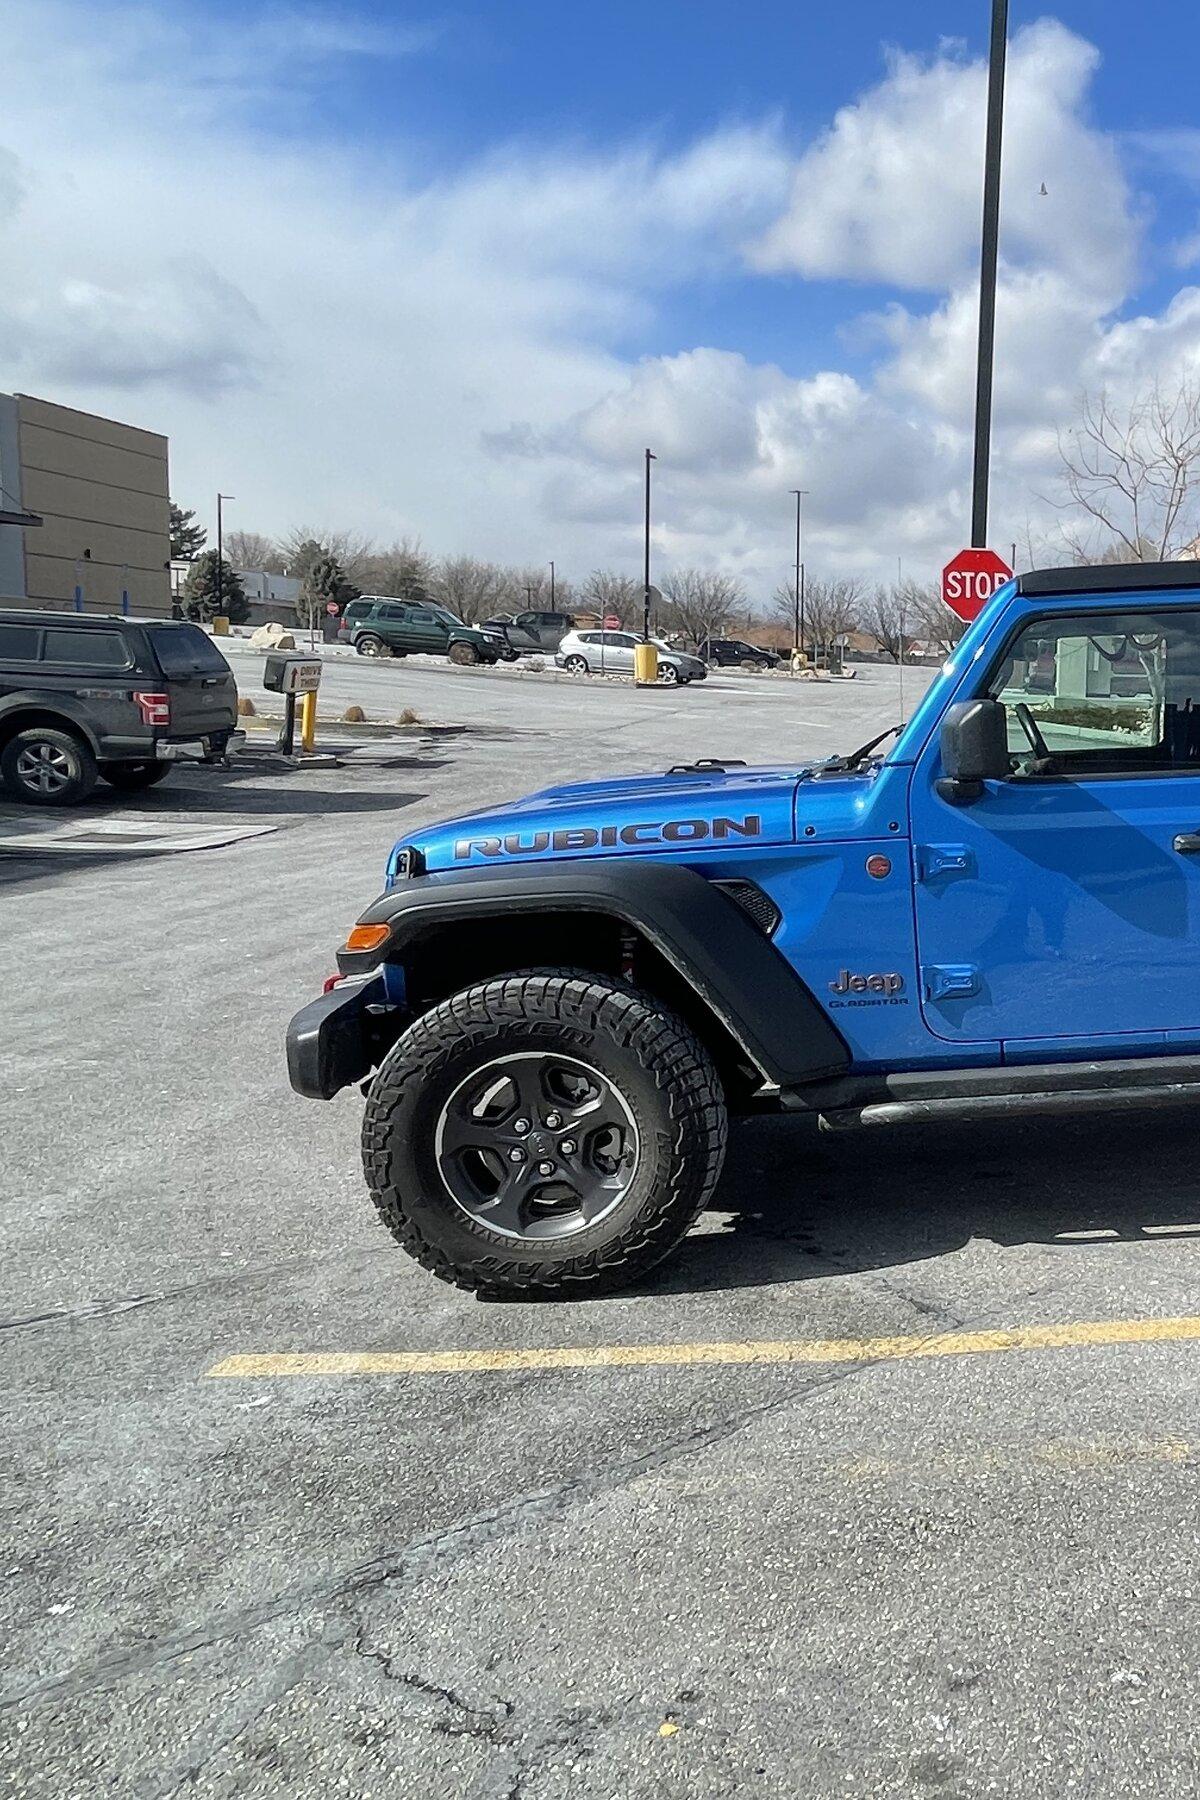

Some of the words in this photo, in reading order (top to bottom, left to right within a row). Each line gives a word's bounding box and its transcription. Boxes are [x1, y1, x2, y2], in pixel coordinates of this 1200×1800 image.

[946, 571, 1010, 599] STOP
[454, 815, 761, 860] RUBICON
[828, 969, 904, 996] Jeep
[828, 998, 909, 1009] GLADIATOR
